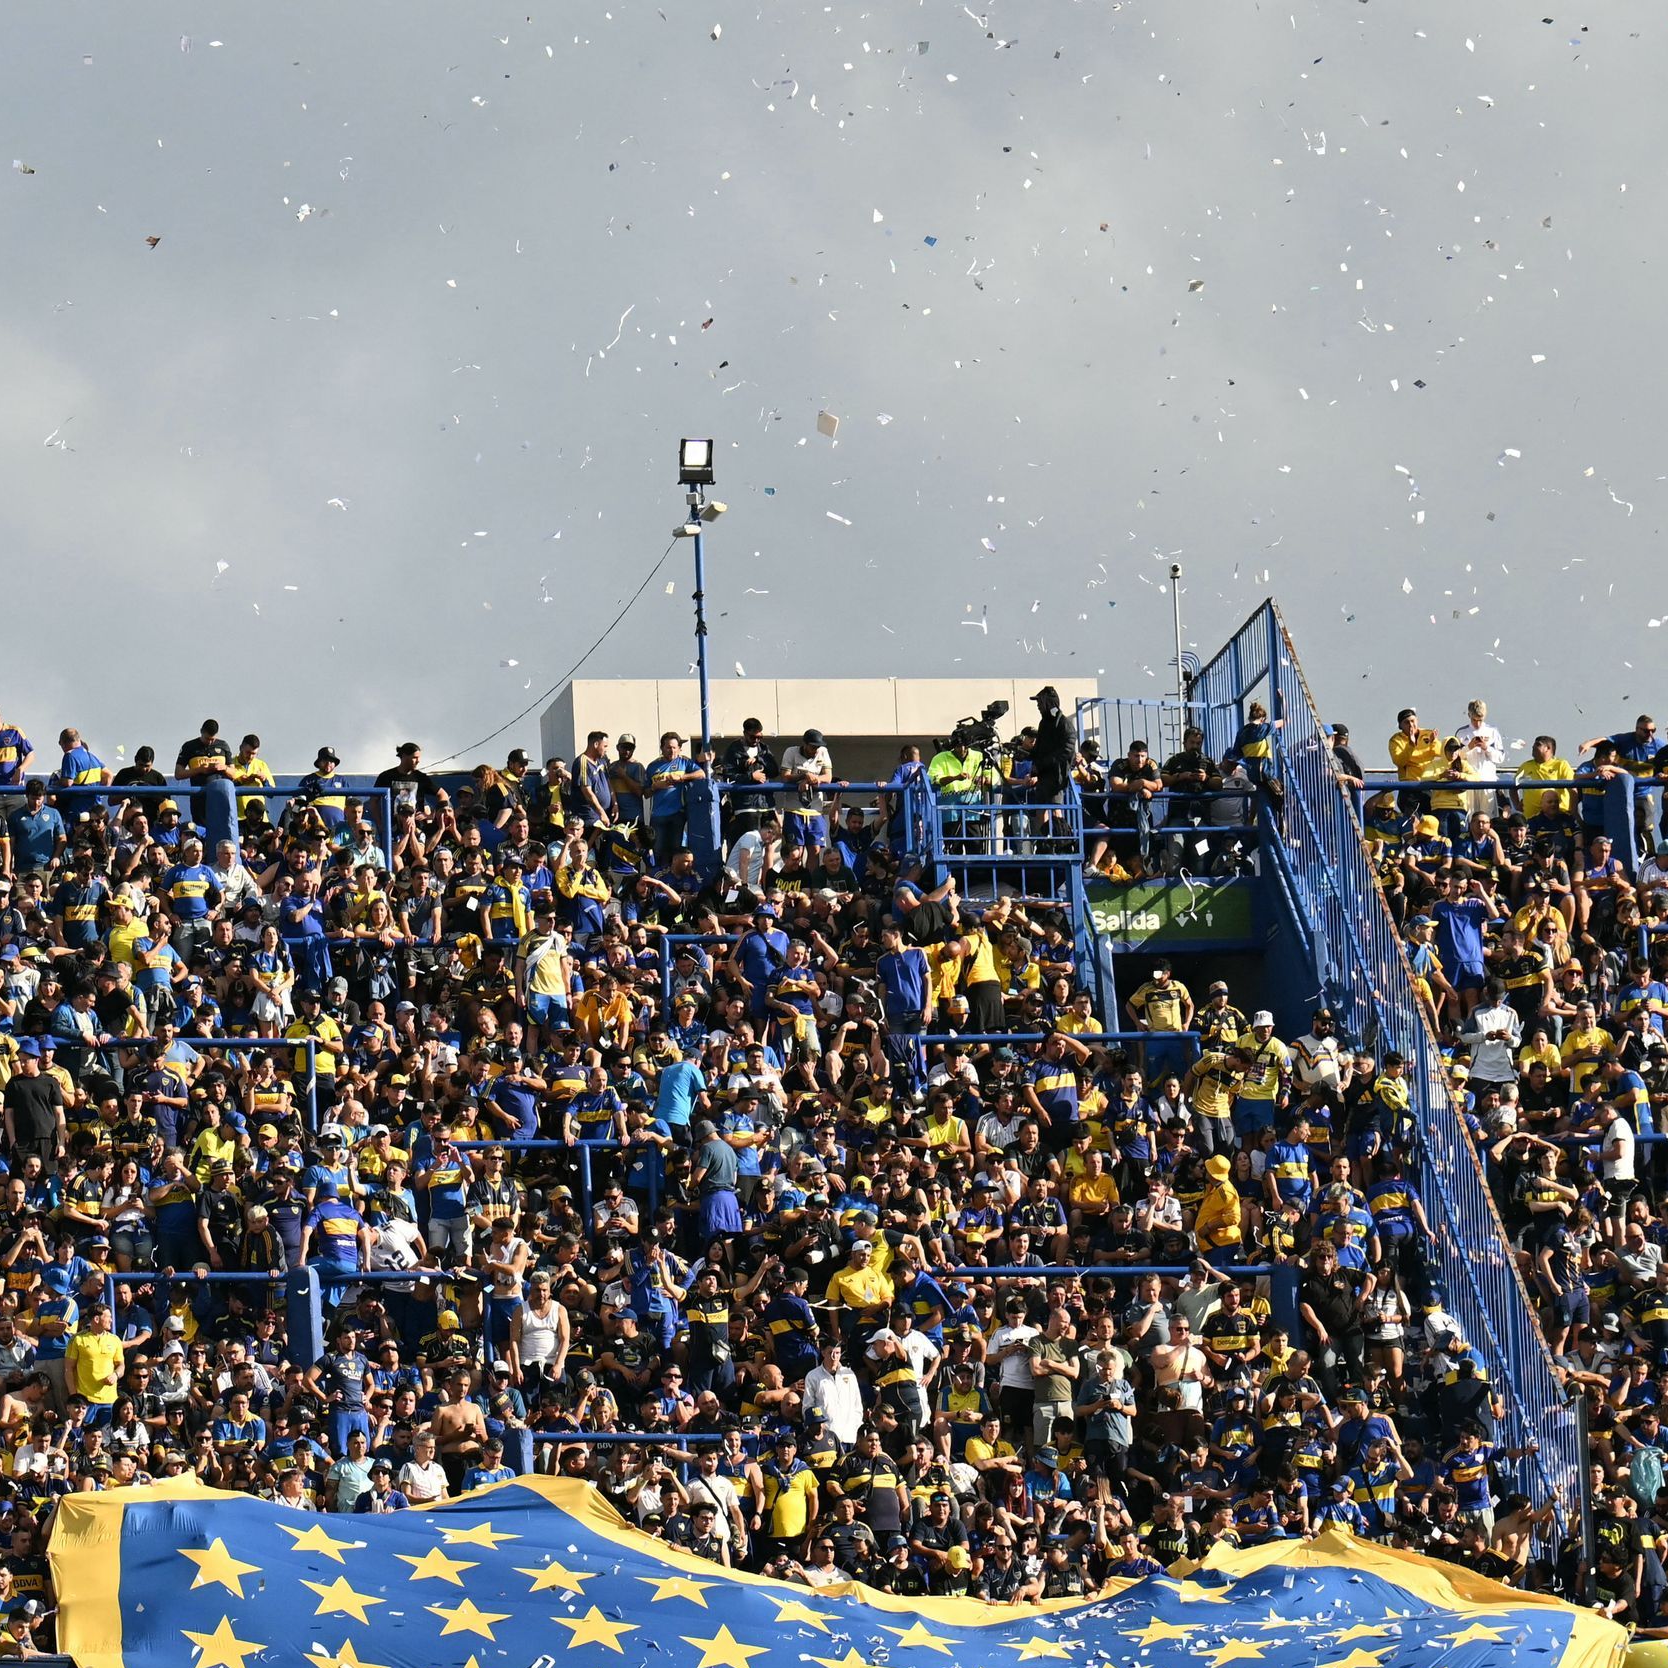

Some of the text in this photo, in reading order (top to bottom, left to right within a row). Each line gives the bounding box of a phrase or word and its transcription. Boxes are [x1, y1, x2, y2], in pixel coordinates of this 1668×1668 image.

[1091, 910, 1160, 932] Salida
[342, 1368, 363, 1377] QATAR
[13, 1577, 38, 1588] BBVA
